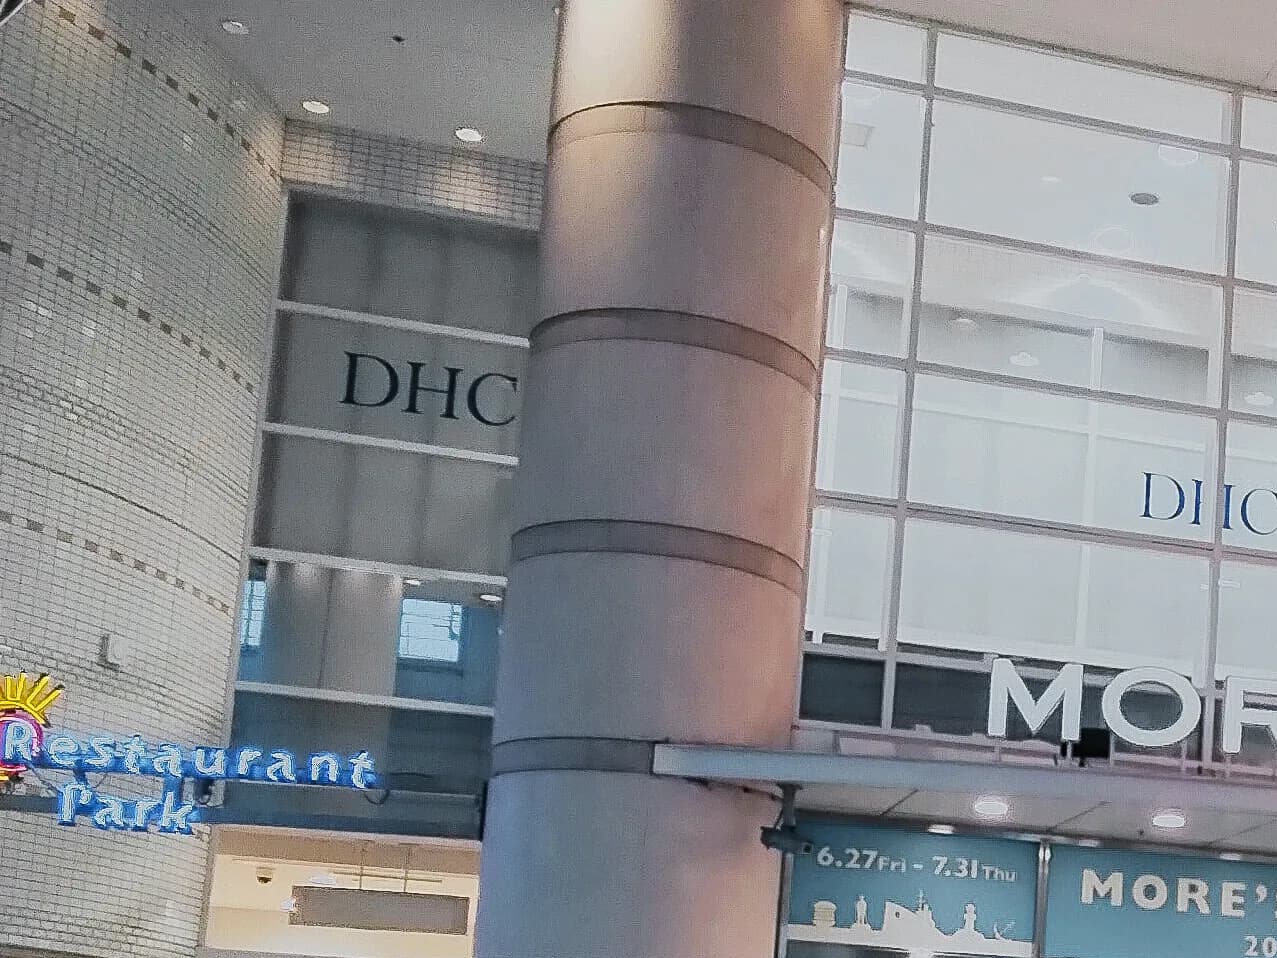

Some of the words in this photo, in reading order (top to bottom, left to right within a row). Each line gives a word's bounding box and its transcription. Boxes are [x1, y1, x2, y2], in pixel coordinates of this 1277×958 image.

[338, 351, 518, 426] DHC
[4, 721, 376, 788] Restaurant
[60, 782, 194, 832] Park
